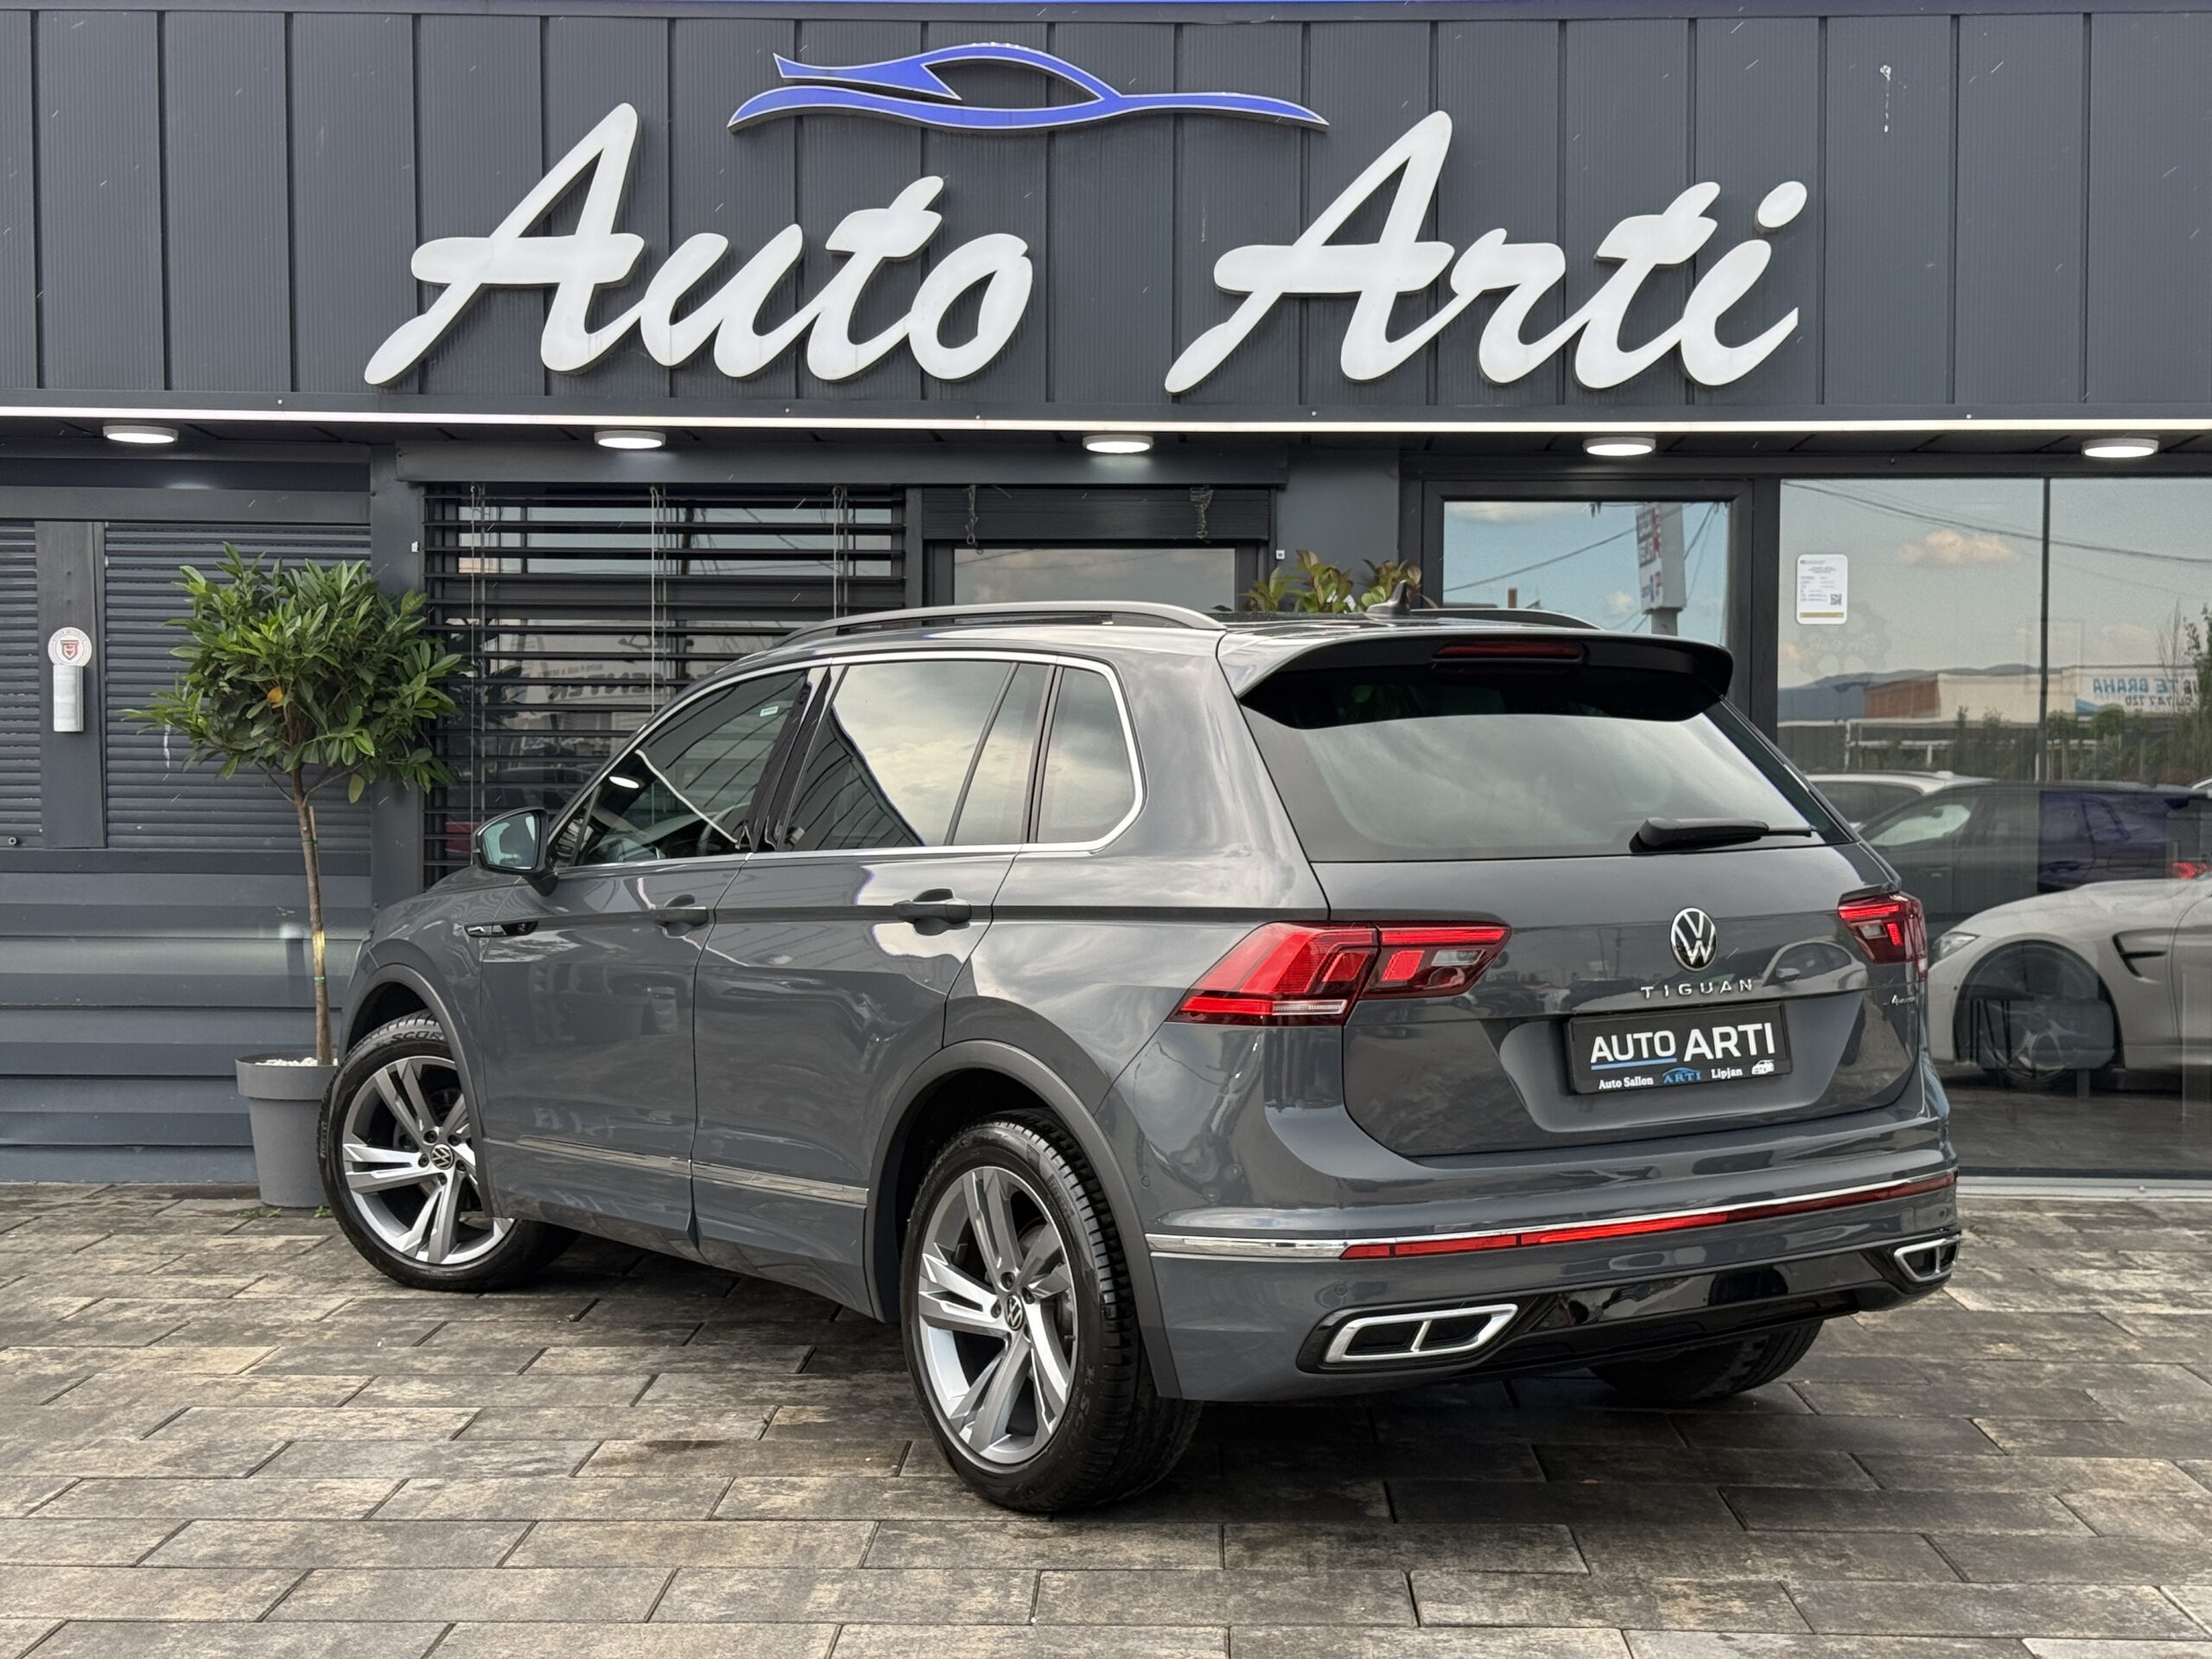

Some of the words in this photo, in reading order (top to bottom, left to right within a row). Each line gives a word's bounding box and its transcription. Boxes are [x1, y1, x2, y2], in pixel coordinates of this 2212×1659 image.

[364, 102, 1033, 386] Auto
[1164, 110, 1808, 394] Arti
[1640, 978, 1753, 1000] TIGUAN
[1590, 1030, 1677, 1065] AUTO
[1683, 1022, 1776, 1063] ARTI
[1598, 1079, 1623, 1090] Auto
[1662, 1071, 1701, 1084] ARTI
[1711, 1067, 1744, 1079] Lipjan
